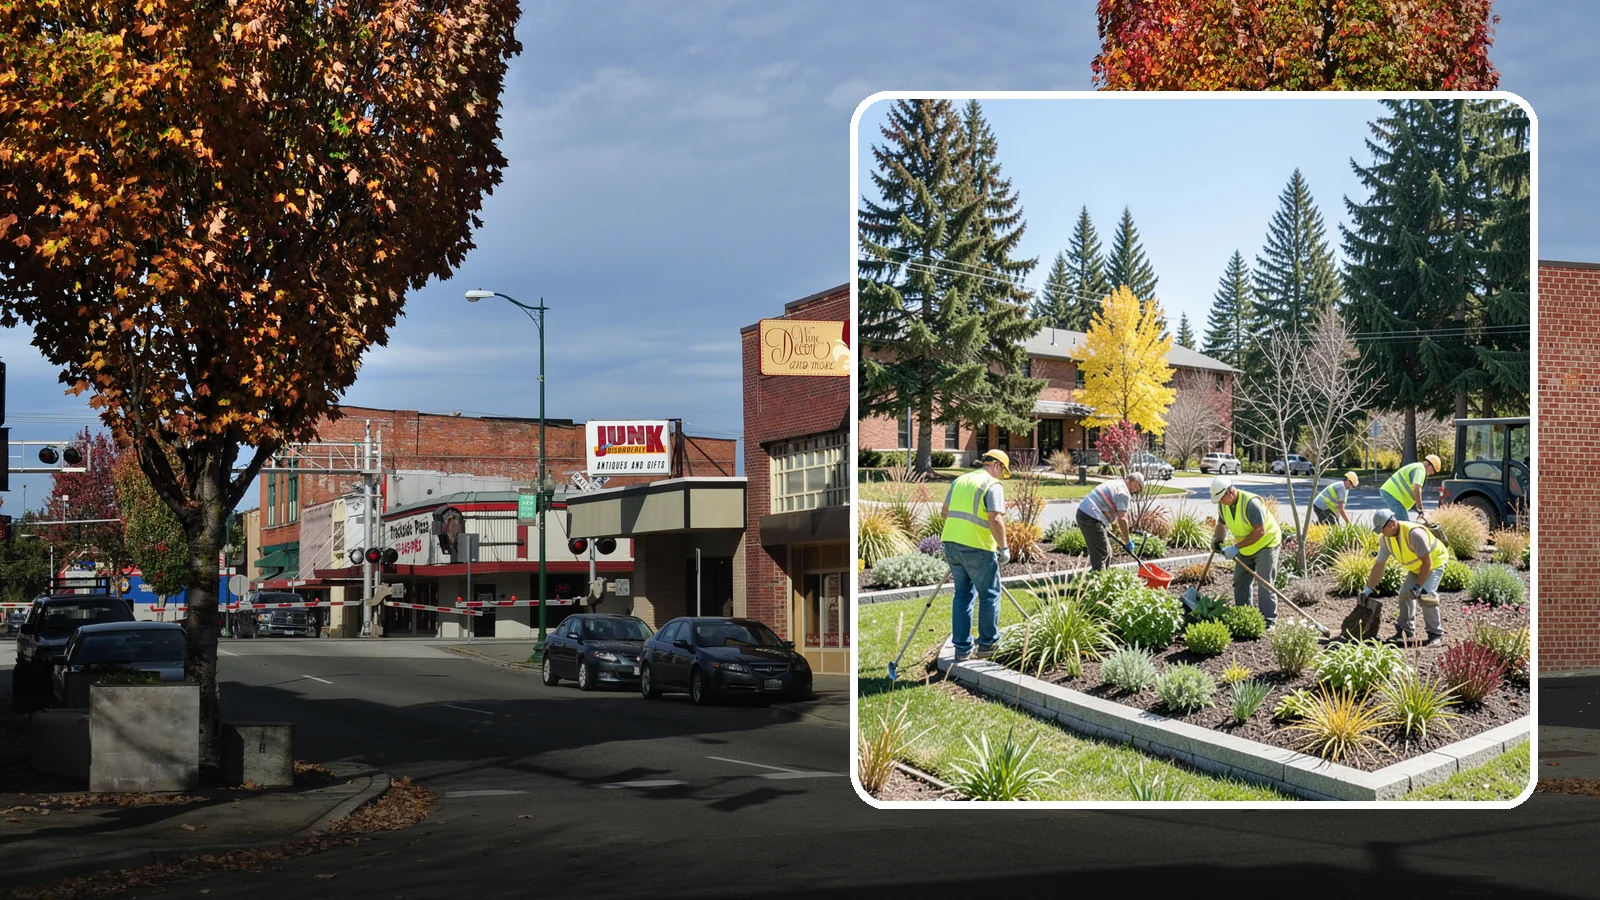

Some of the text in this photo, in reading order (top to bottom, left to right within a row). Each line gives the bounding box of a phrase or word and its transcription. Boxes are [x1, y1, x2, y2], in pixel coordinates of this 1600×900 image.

[765, 328, 831, 365] Decor
[595, 425, 665, 457] JUNK
[597, 460, 665, 470] ANTIQUES AND GIFTS
[390, 519, 429, 539] Trackside Pizza
